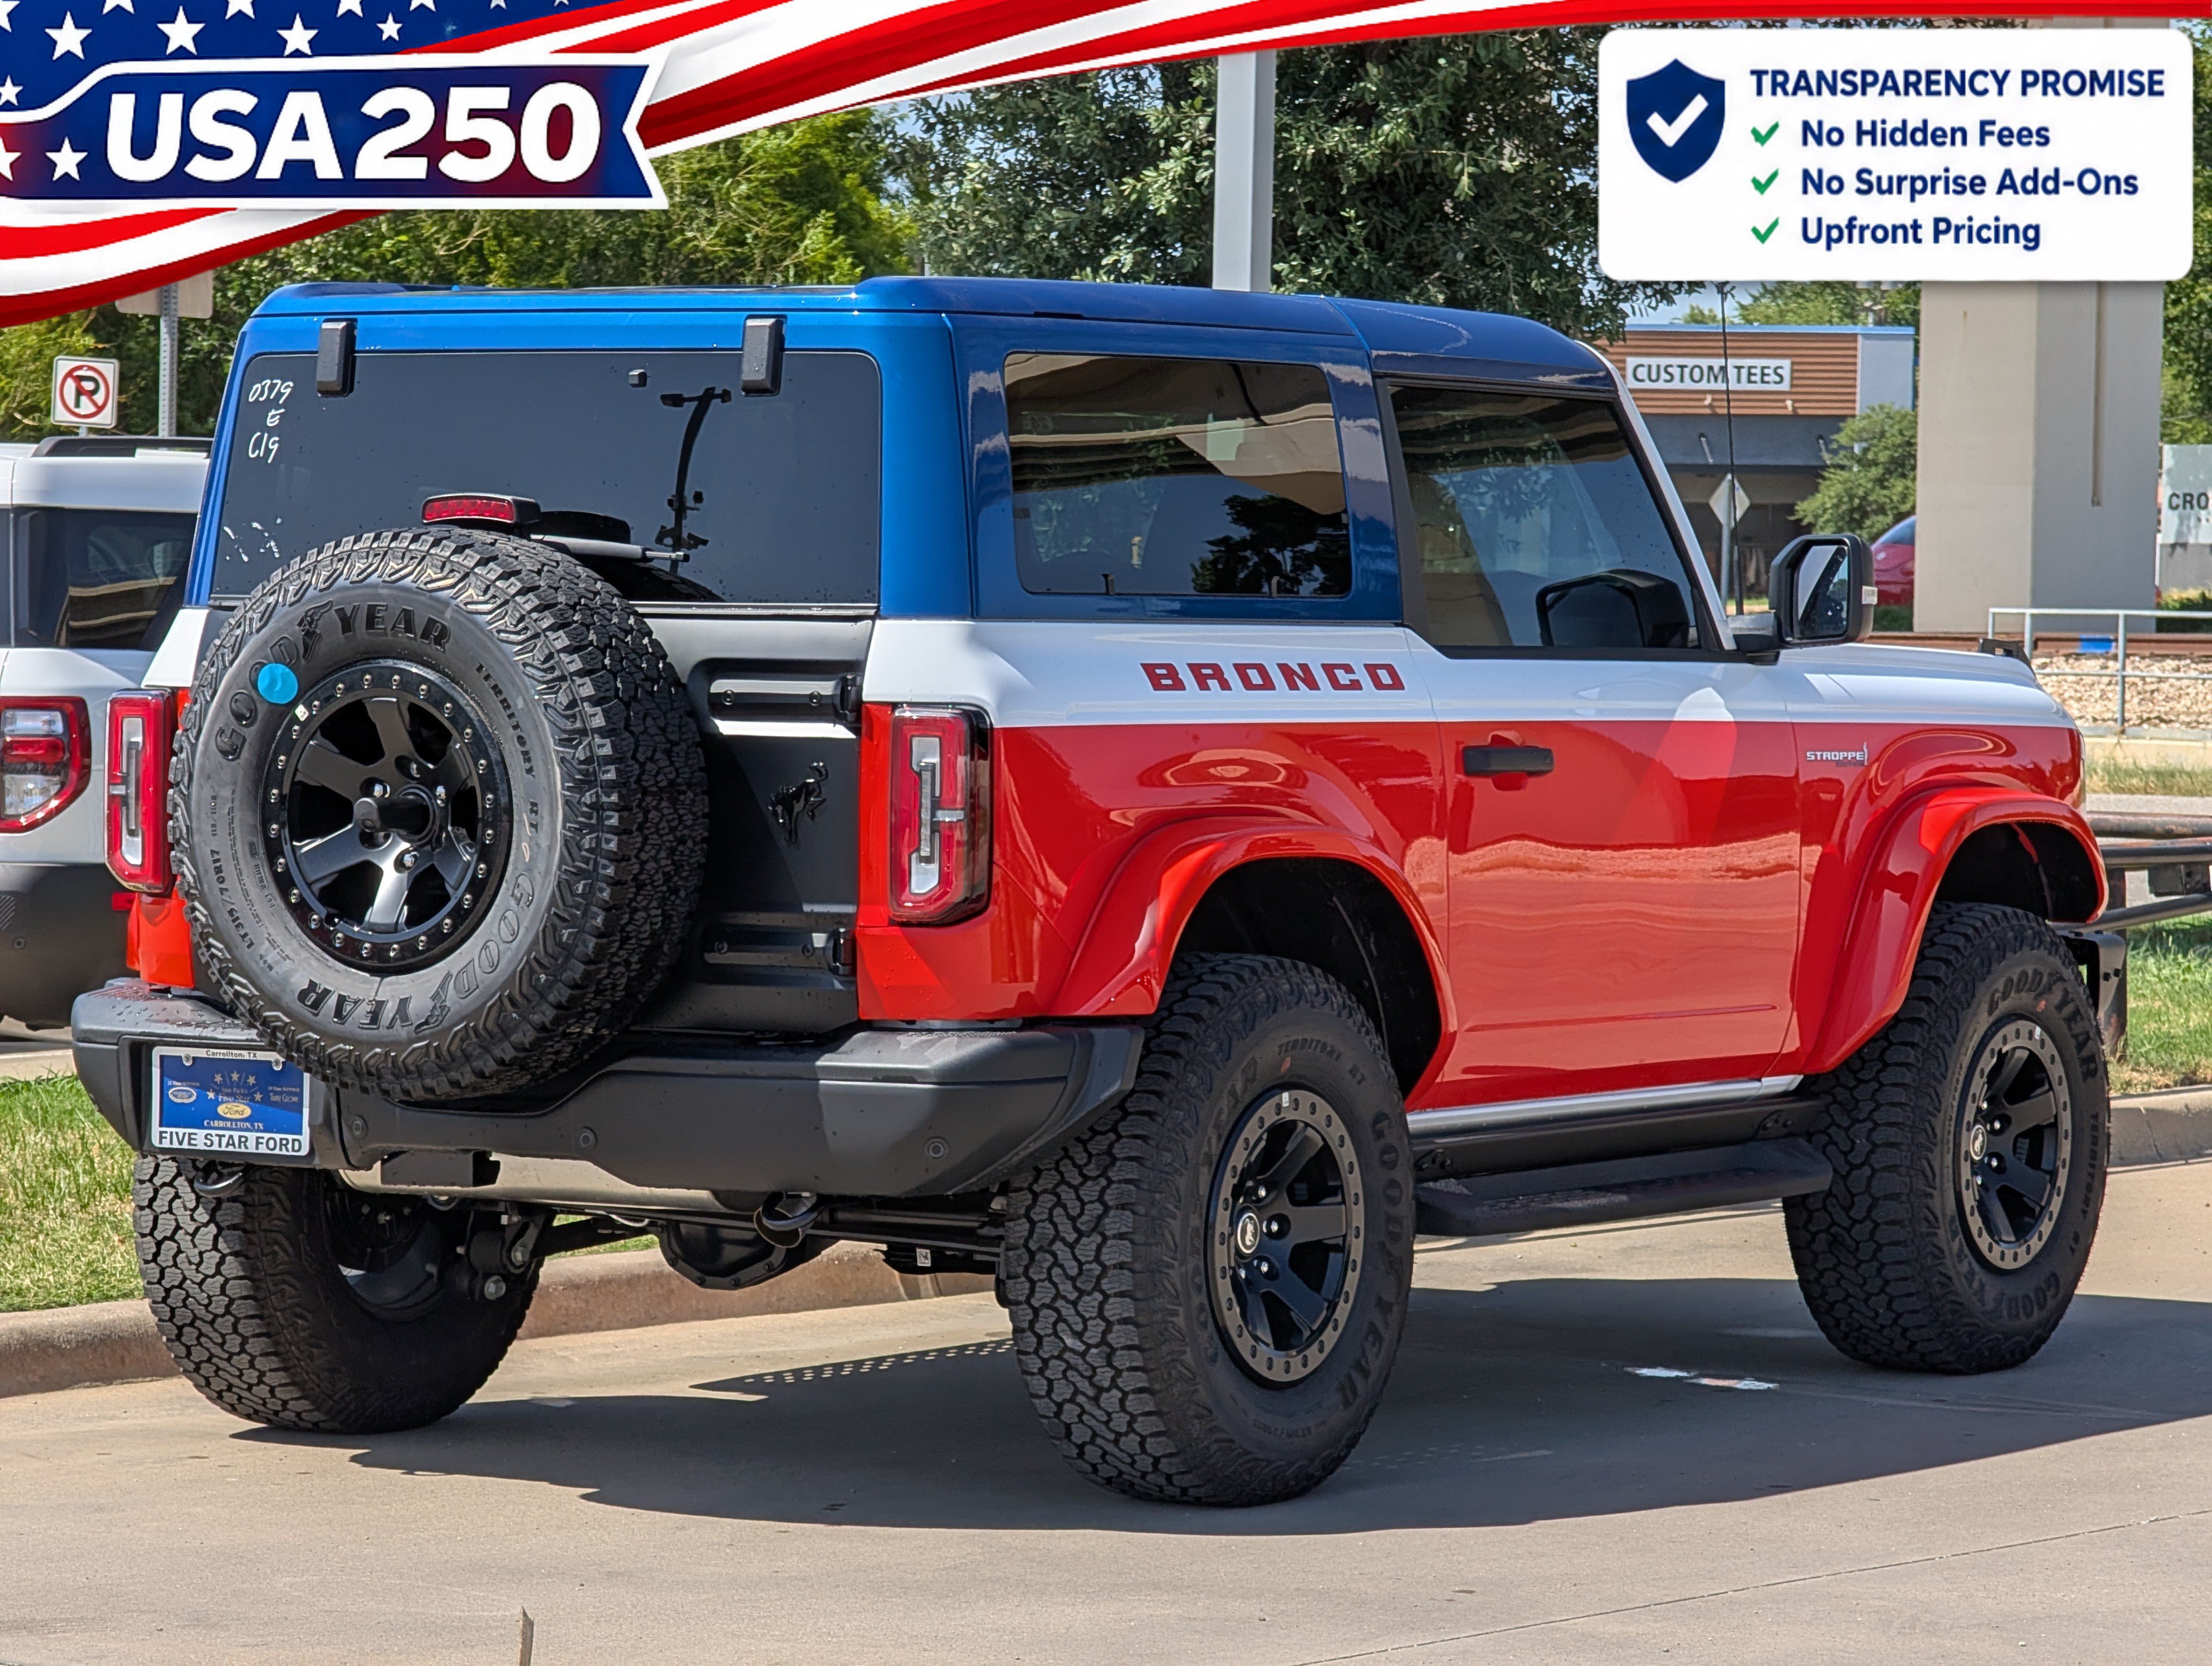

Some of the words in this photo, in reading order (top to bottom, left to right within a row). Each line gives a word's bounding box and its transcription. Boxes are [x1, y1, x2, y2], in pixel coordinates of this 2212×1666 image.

[1632, 364, 1726, 383] CUSTOM
[1733, 365, 1784, 385] TEES
[1141, 663, 1405, 691] BRONCO
[475, 661, 535, 778] TERRITORY
[529, 800, 538, 834] RT
[1806, 752, 1864, 760] STROPPE
[222, 1104, 246, 1116] Ford
[158, 1130, 198, 1148] FIVE
[203, 1132, 249, 1150] STAR
[255, 1136, 302, 1154] FORD
